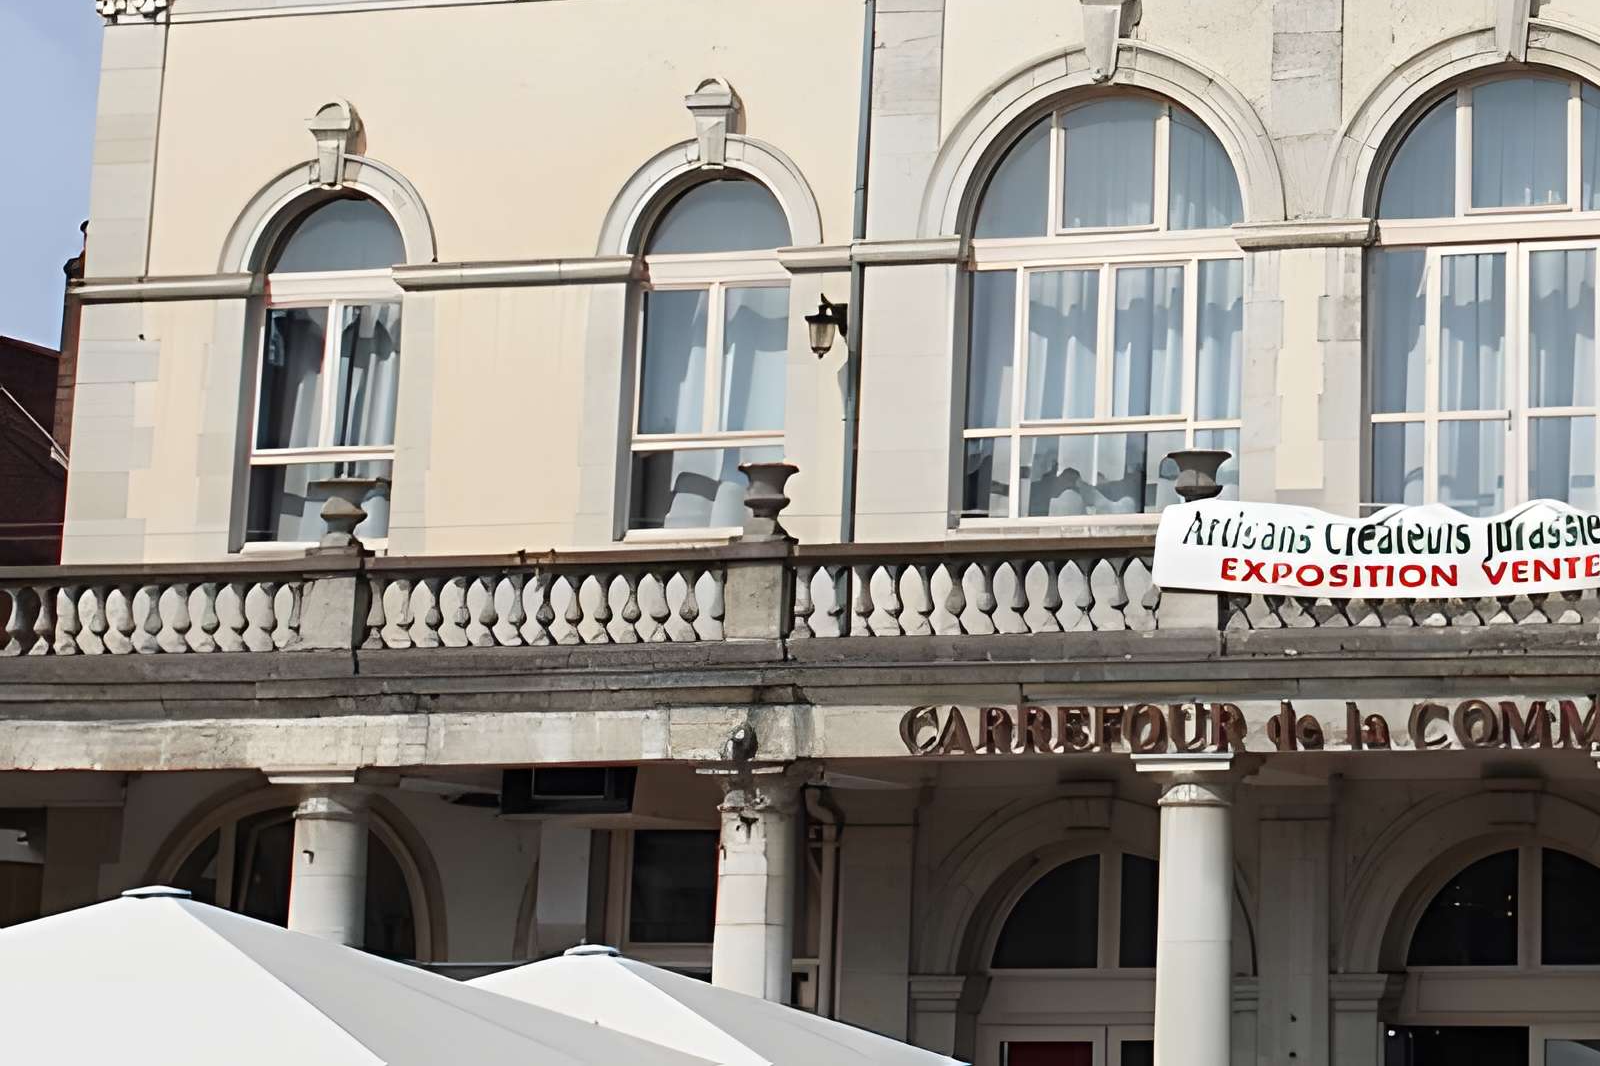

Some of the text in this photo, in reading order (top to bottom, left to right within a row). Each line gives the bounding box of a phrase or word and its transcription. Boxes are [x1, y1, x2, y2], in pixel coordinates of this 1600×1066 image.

[1220, 554, 1600, 587] EXPOSITION VENTE
[899, 703, 1247, 756] CARREFOUR
[1266, 699, 1324, 751] de
[1345, 701, 1392, 750] la
